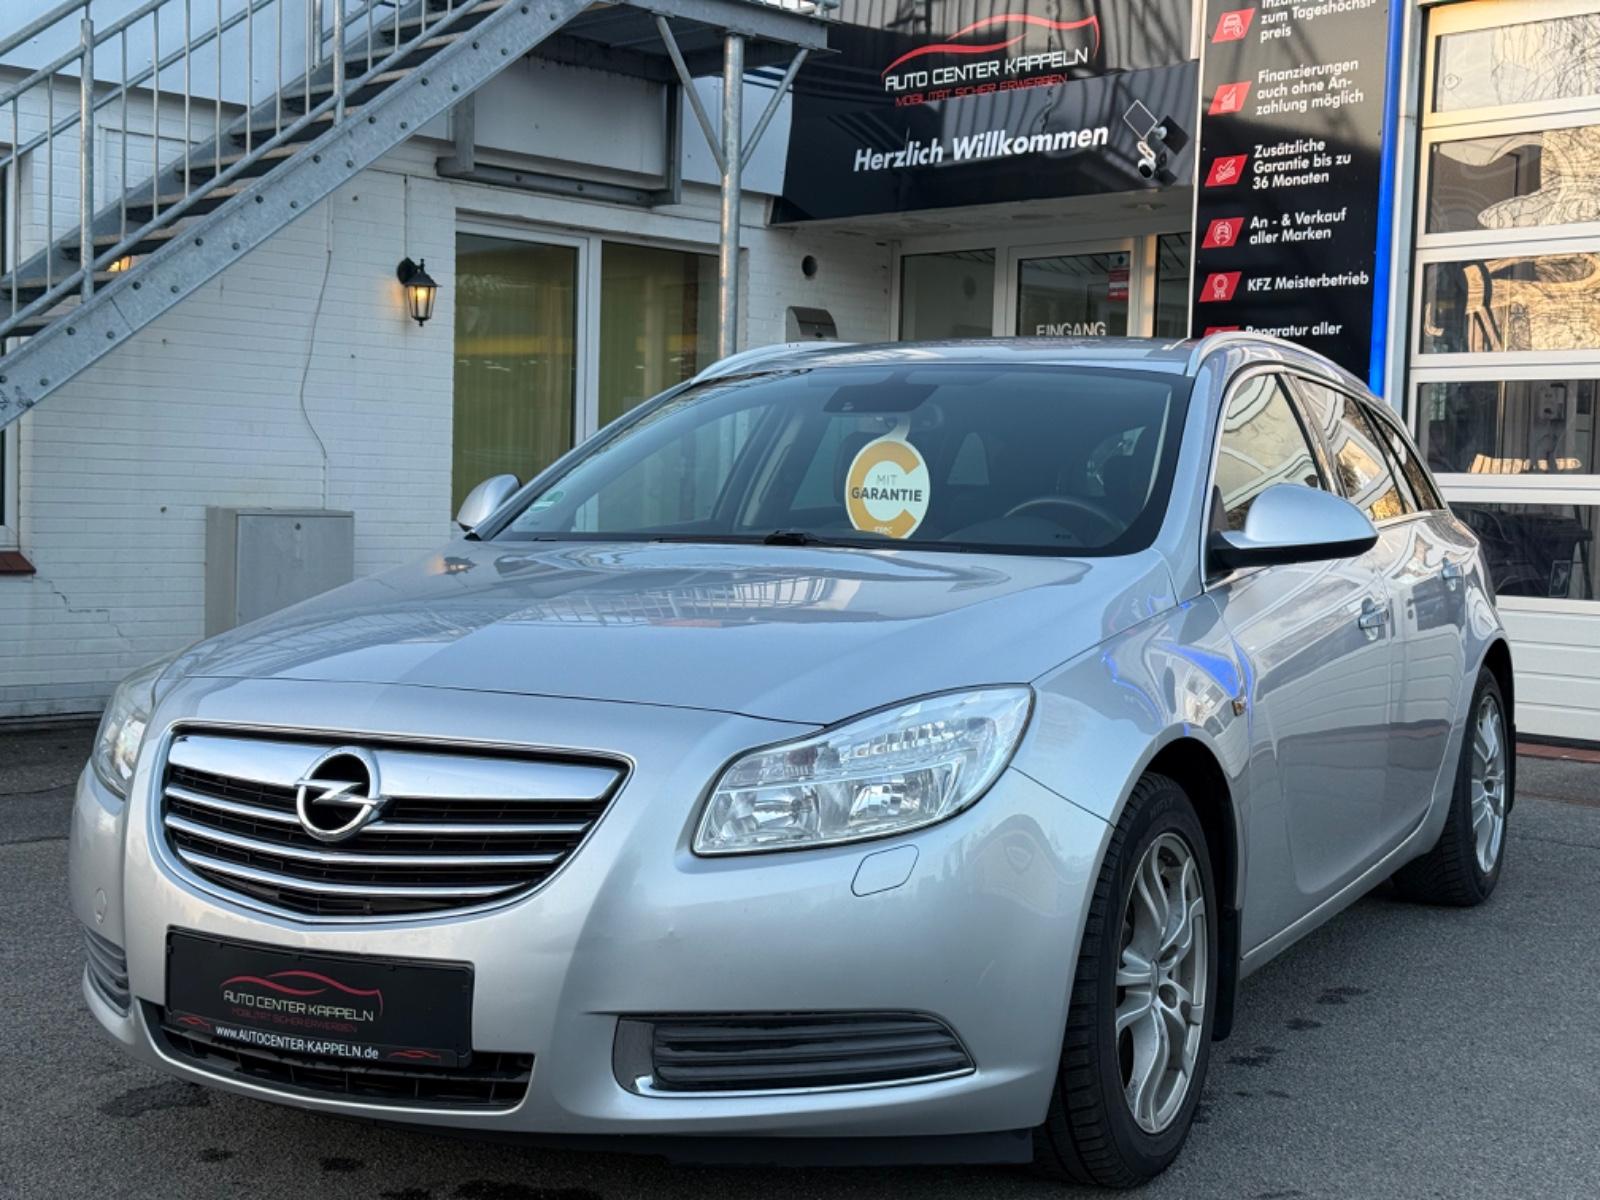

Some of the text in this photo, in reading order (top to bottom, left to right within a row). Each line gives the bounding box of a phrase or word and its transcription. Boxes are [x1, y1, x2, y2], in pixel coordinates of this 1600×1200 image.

[1261, 11, 1288, 24] zum
[1260, 23, 1292, 43] preis
[885, 47, 1088, 92] AUTO CENTER KAPPELN
[1258, 60, 1359, 84] Finanzierungen
[1257, 76, 1352, 100] auch ohne An-
[1256, 89, 1364, 116] zahlung möglich
[853, 126, 1109, 172] Herzlich Willkommen
[1253, 138, 1326, 159] Zusätzliche
[1253, 152, 1352, 174] Garantie bis zu
[1252, 172, 1329, 190] 36 Monaten
[1250, 216, 1268, 230] An
[1281, 213, 1291, 227] &
[1295, 207, 1347, 225] Verkauf
[1249, 226, 1332, 245] aller Marken
[1247, 270, 1369, 292] KFZ Meisterbetrieb
[1312, 321, 1343, 335] aller
[876, 474, 898, 486] MIT
[851, 486, 923, 503] GARANTIE
[223, 990, 374, 1022] AUTO CENTER KAPPELN
[216, 1026, 379, 1060] www.AUTOCENTER-KAPPELN.de
